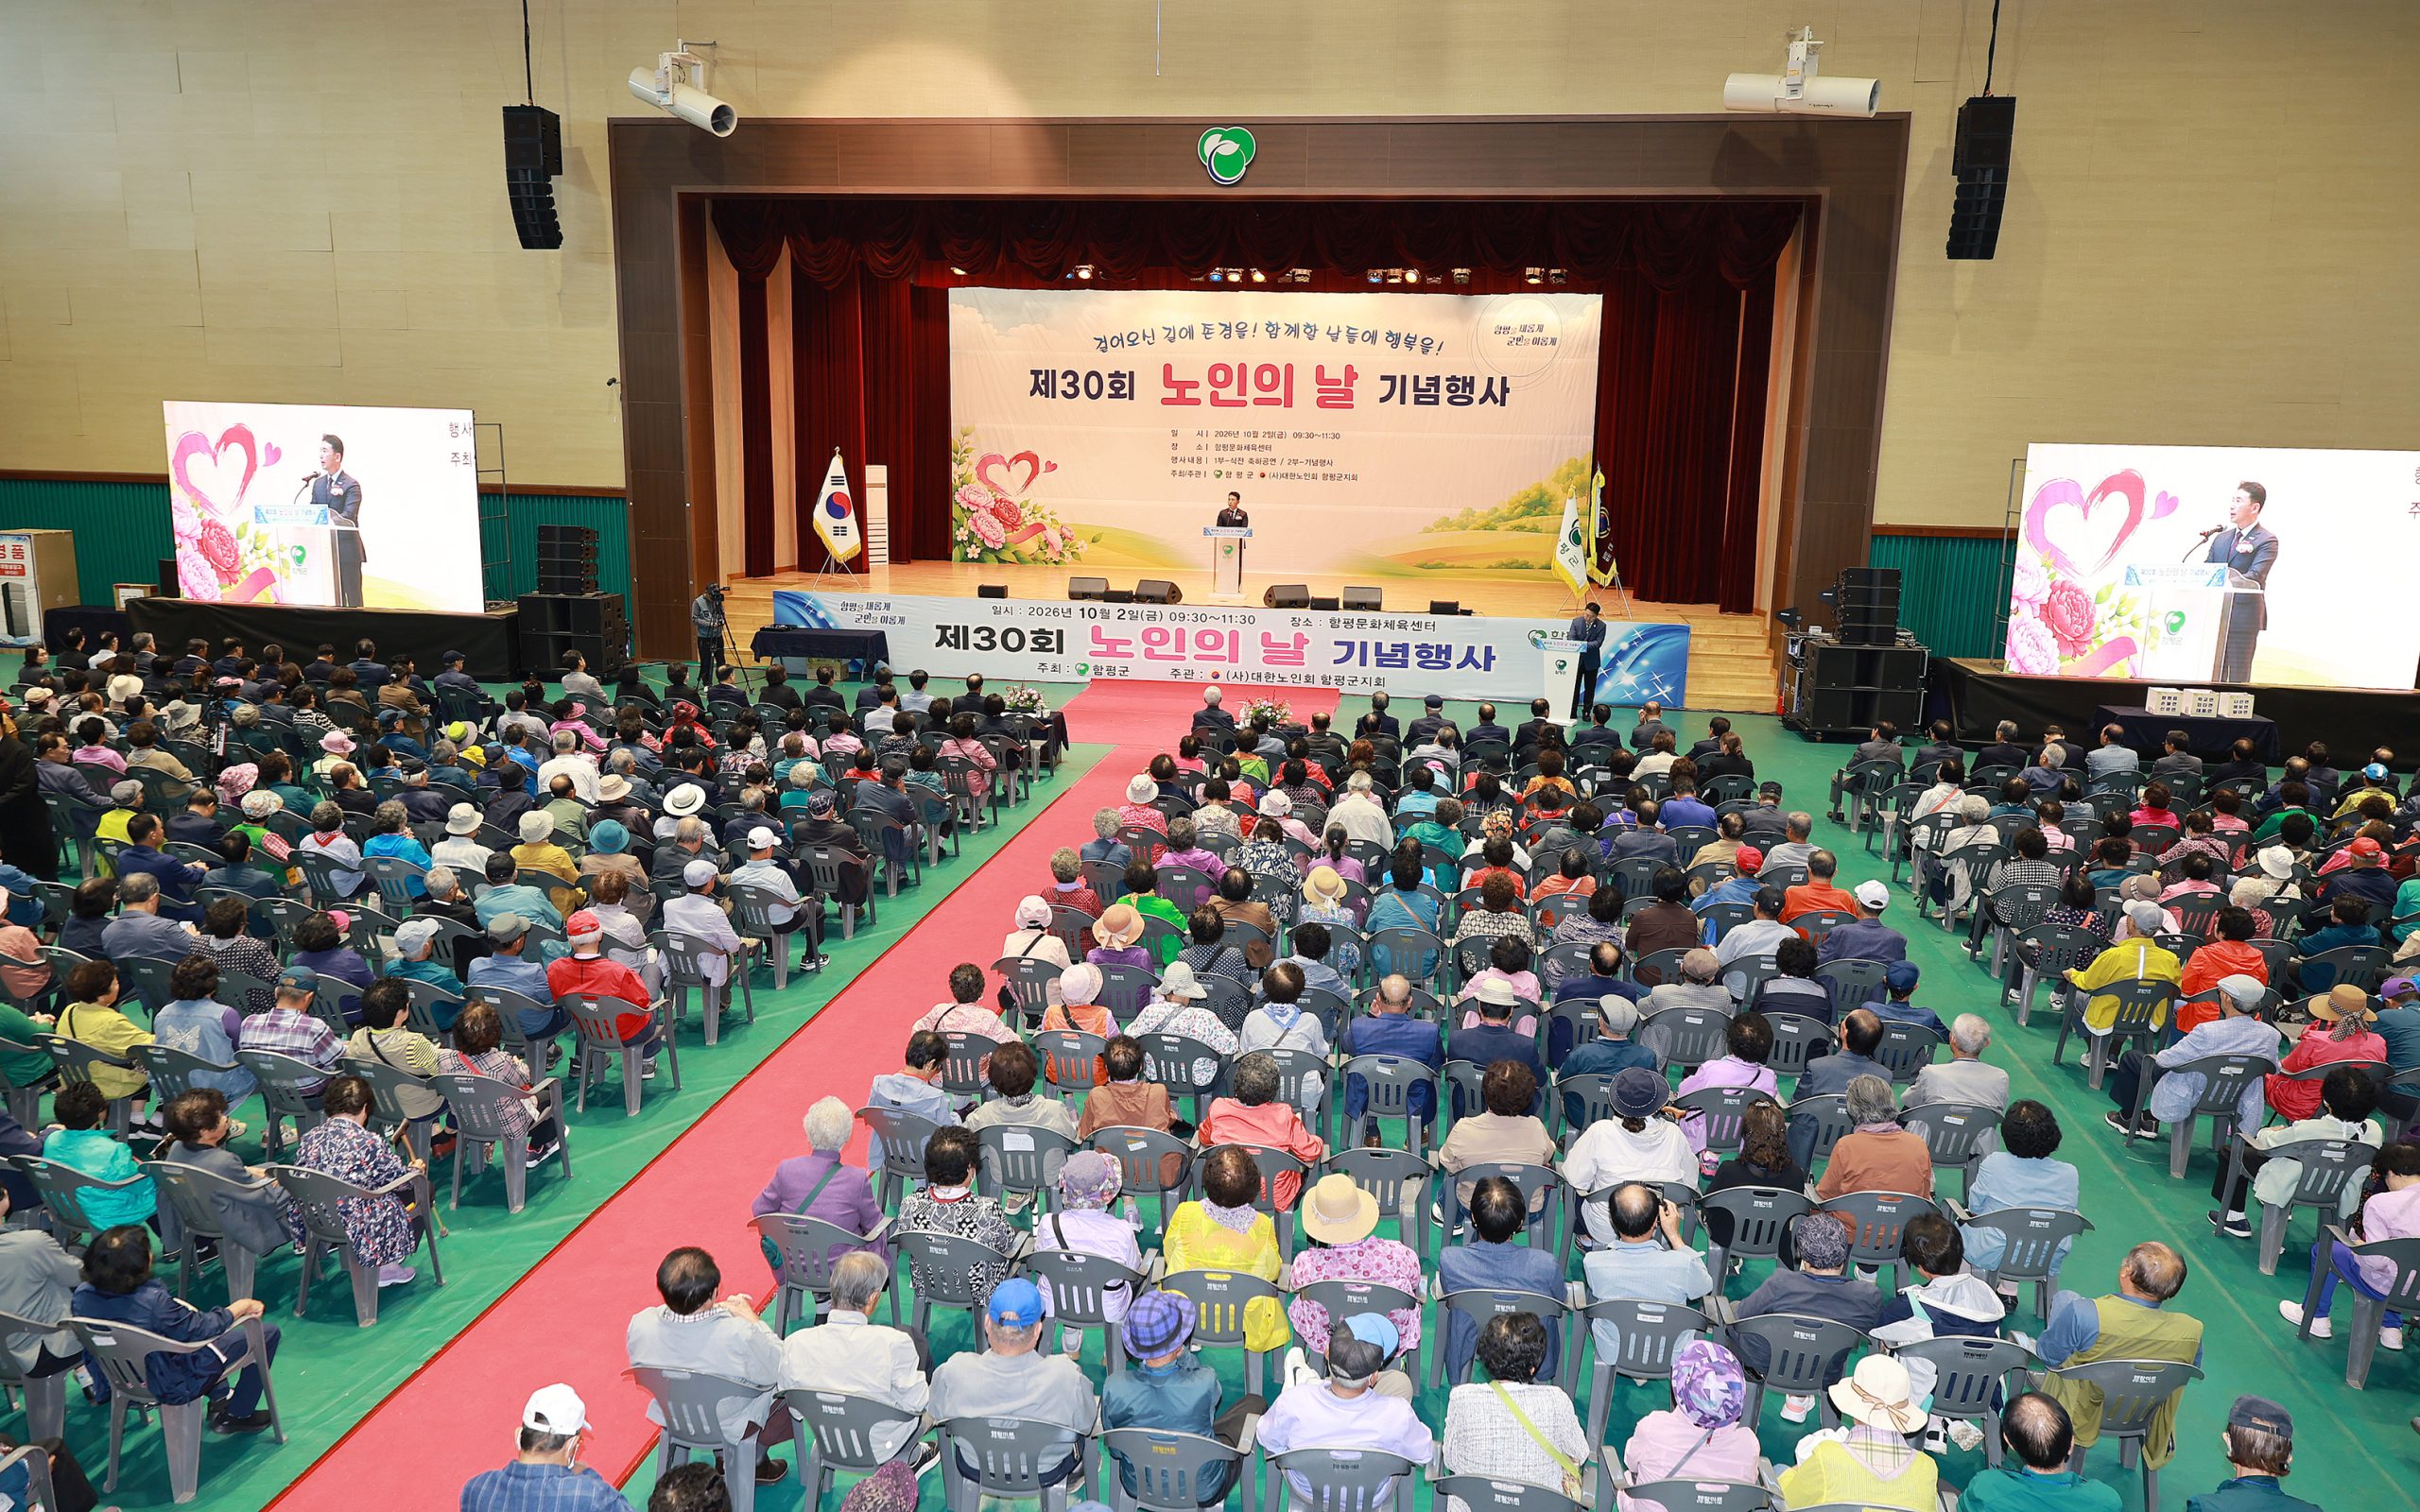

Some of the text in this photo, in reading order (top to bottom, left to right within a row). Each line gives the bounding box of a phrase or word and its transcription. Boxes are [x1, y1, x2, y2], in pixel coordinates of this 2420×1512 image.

[1093, 320, 1444, 355] 걸어오신 길에 존경을! 함께할 날들에 행복을!
[1029, 362, 1511, 409] 제30회 노인의 날 기념행사
[449, 421, 473, 438] 행사
[1214, 430, 1239, 438] 2026년
[1243, 430, 1259, 438] 10월
[1262, 430, 1287, 439] 2일(금)
[1292, 431, 1340, 439] 09:30~11:30
[1215, 443, 1272, 452] 함평문화체육센터
[1248, 457, 1276, 466] 축하공연
[1170, 470, 1201, 478] 주최/주관
[1322, 472, 1358, 481] 함평군지회
[839, 600, 891, 612] 함평을 새롭게
[855, 612, 906, 626] 군민을 이롭게
[992, 606, 1013, 615] 일시
[1028, 606, 1072, 619] 2026년
[1079, 607, 1111, 620] 10월
[1116, 608, 1164, 622] 2일(금)
[1169, 611, 1256, 626] 09:30~11:30
[1289, 616, 1314, 628] 장소
[1328, 617, 1437, 632] 함평문화체육센터
[935, 625, 1496, 672] 제30회 노인의 날 기념행사
[1037, 662, 1062, 675] 주최
[1092, 664, 1130, 678] 함평군
[1169, 668, 1195, 679] 주관
[1226, 670, 1315, 685] (사)대한노인회
[1320, 673, 1386, 688] 함평군지회
